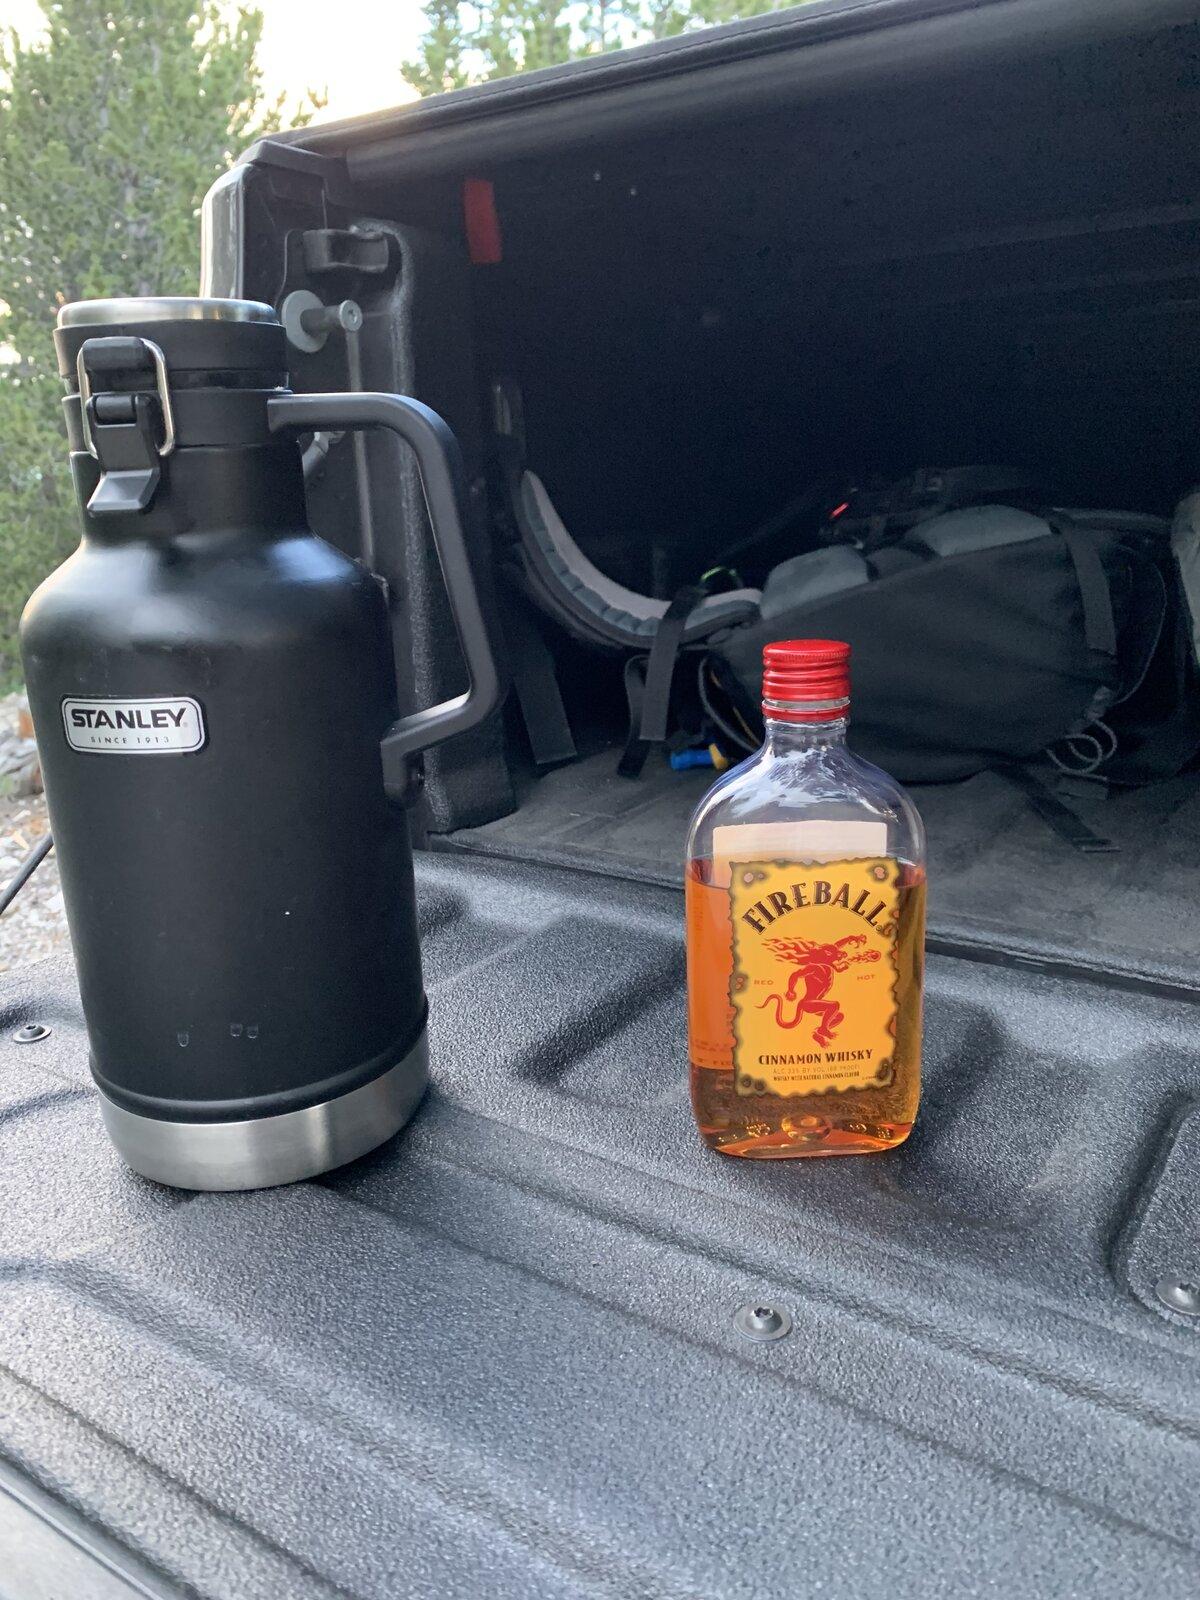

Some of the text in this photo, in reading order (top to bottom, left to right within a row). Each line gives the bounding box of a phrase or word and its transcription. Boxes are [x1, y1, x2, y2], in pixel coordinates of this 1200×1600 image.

[71, 707, 186, 729] STANLEY
[90, 736, 169, 744] SINCE 1913
[742, 880, 887, 934] FIREBALL
[758, 1048, 873, 1066] CINNAMON WHISKY
